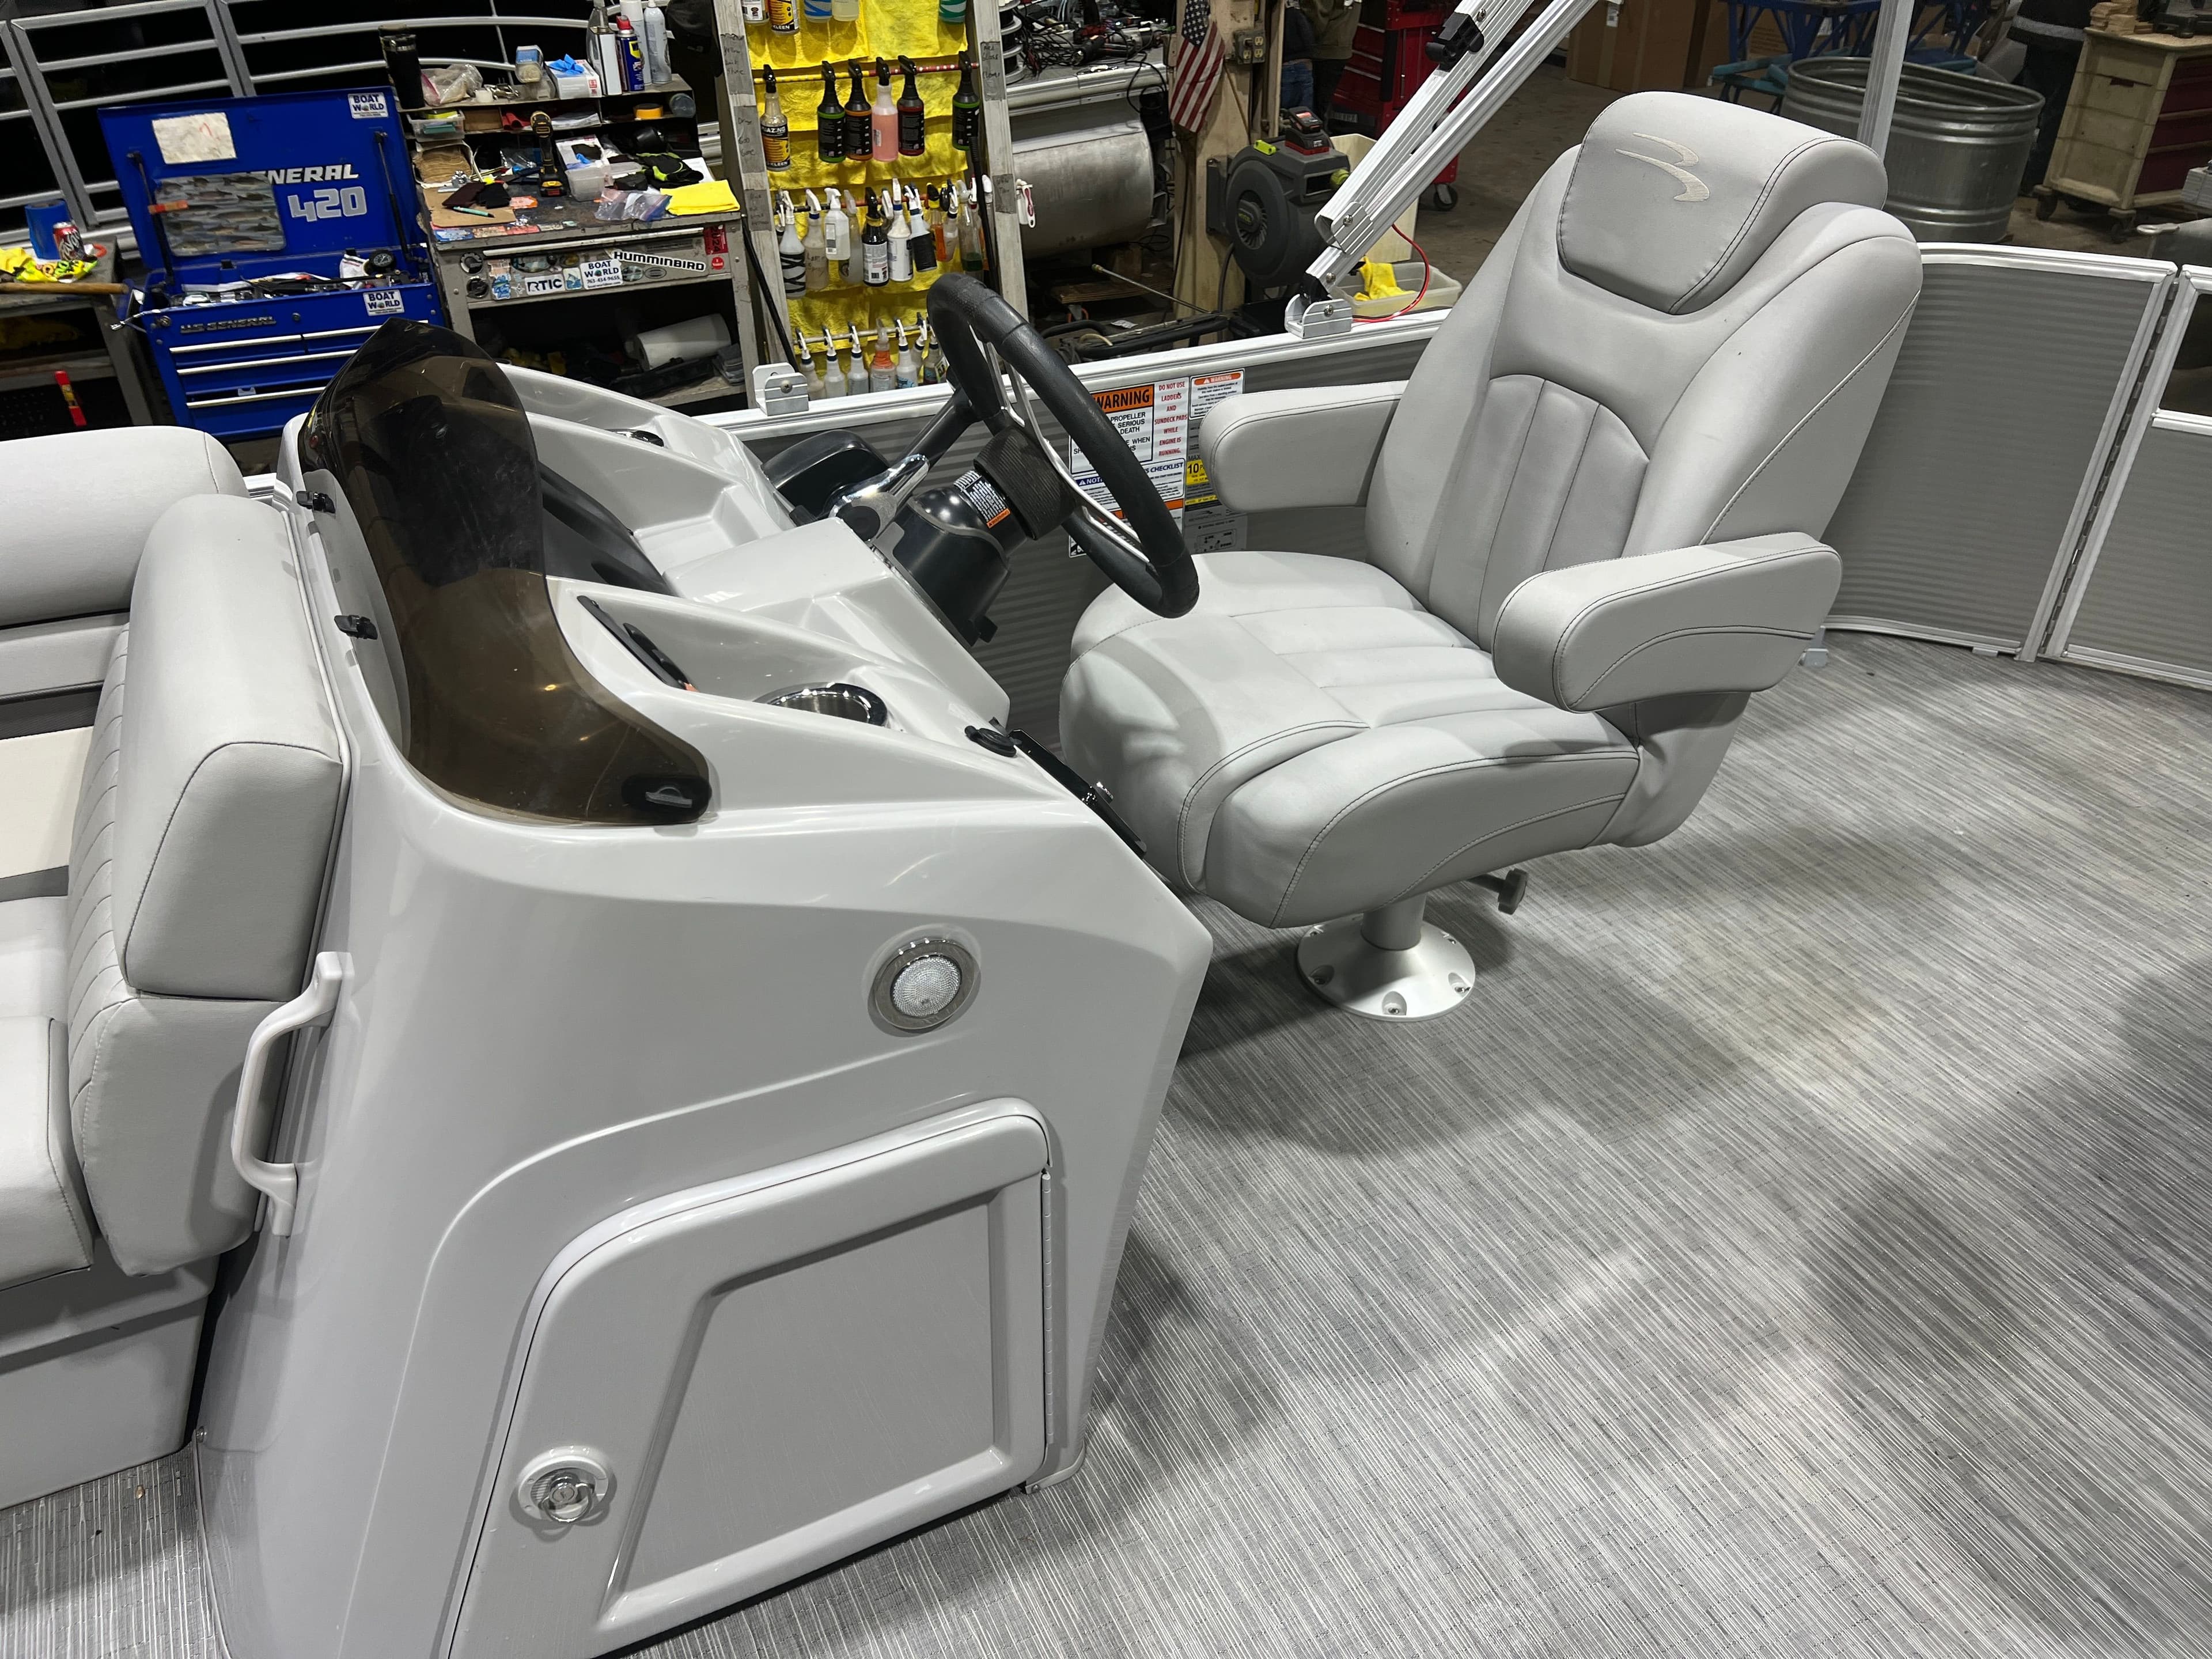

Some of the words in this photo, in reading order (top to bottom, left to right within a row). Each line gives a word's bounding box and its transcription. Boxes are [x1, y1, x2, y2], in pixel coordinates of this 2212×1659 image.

[353, 94, 380, 104] BOAT
[250, 164, 359, 185] NERAL
[287, 185, 368, 222] 420
[588, 260, 611, 270] BOAT
[613, 251, 705, 271] HUMMINBIRD
[527, 279, 563, 292] RTIC
[368, 291, 395, 301] BOAT
[1210, 374, 1232, 383] WARNING
[1161, 393, 1182, 402] LADDERS
[1111, 412, 1146, 422] PROPELLER
[1154, 416, 1175, 425] SUNDECK
[1118, 419, 1145, 429] SERIOUS
[1120, 426, 1140, 435] DEATH
[1132, 436, 1150, 445] WHEN
[1159, 438, 1175, 446] ENGINE
[1150, 462, 1184, 473] CHECKLIST
[1188, 463, 1199, 474] 10
